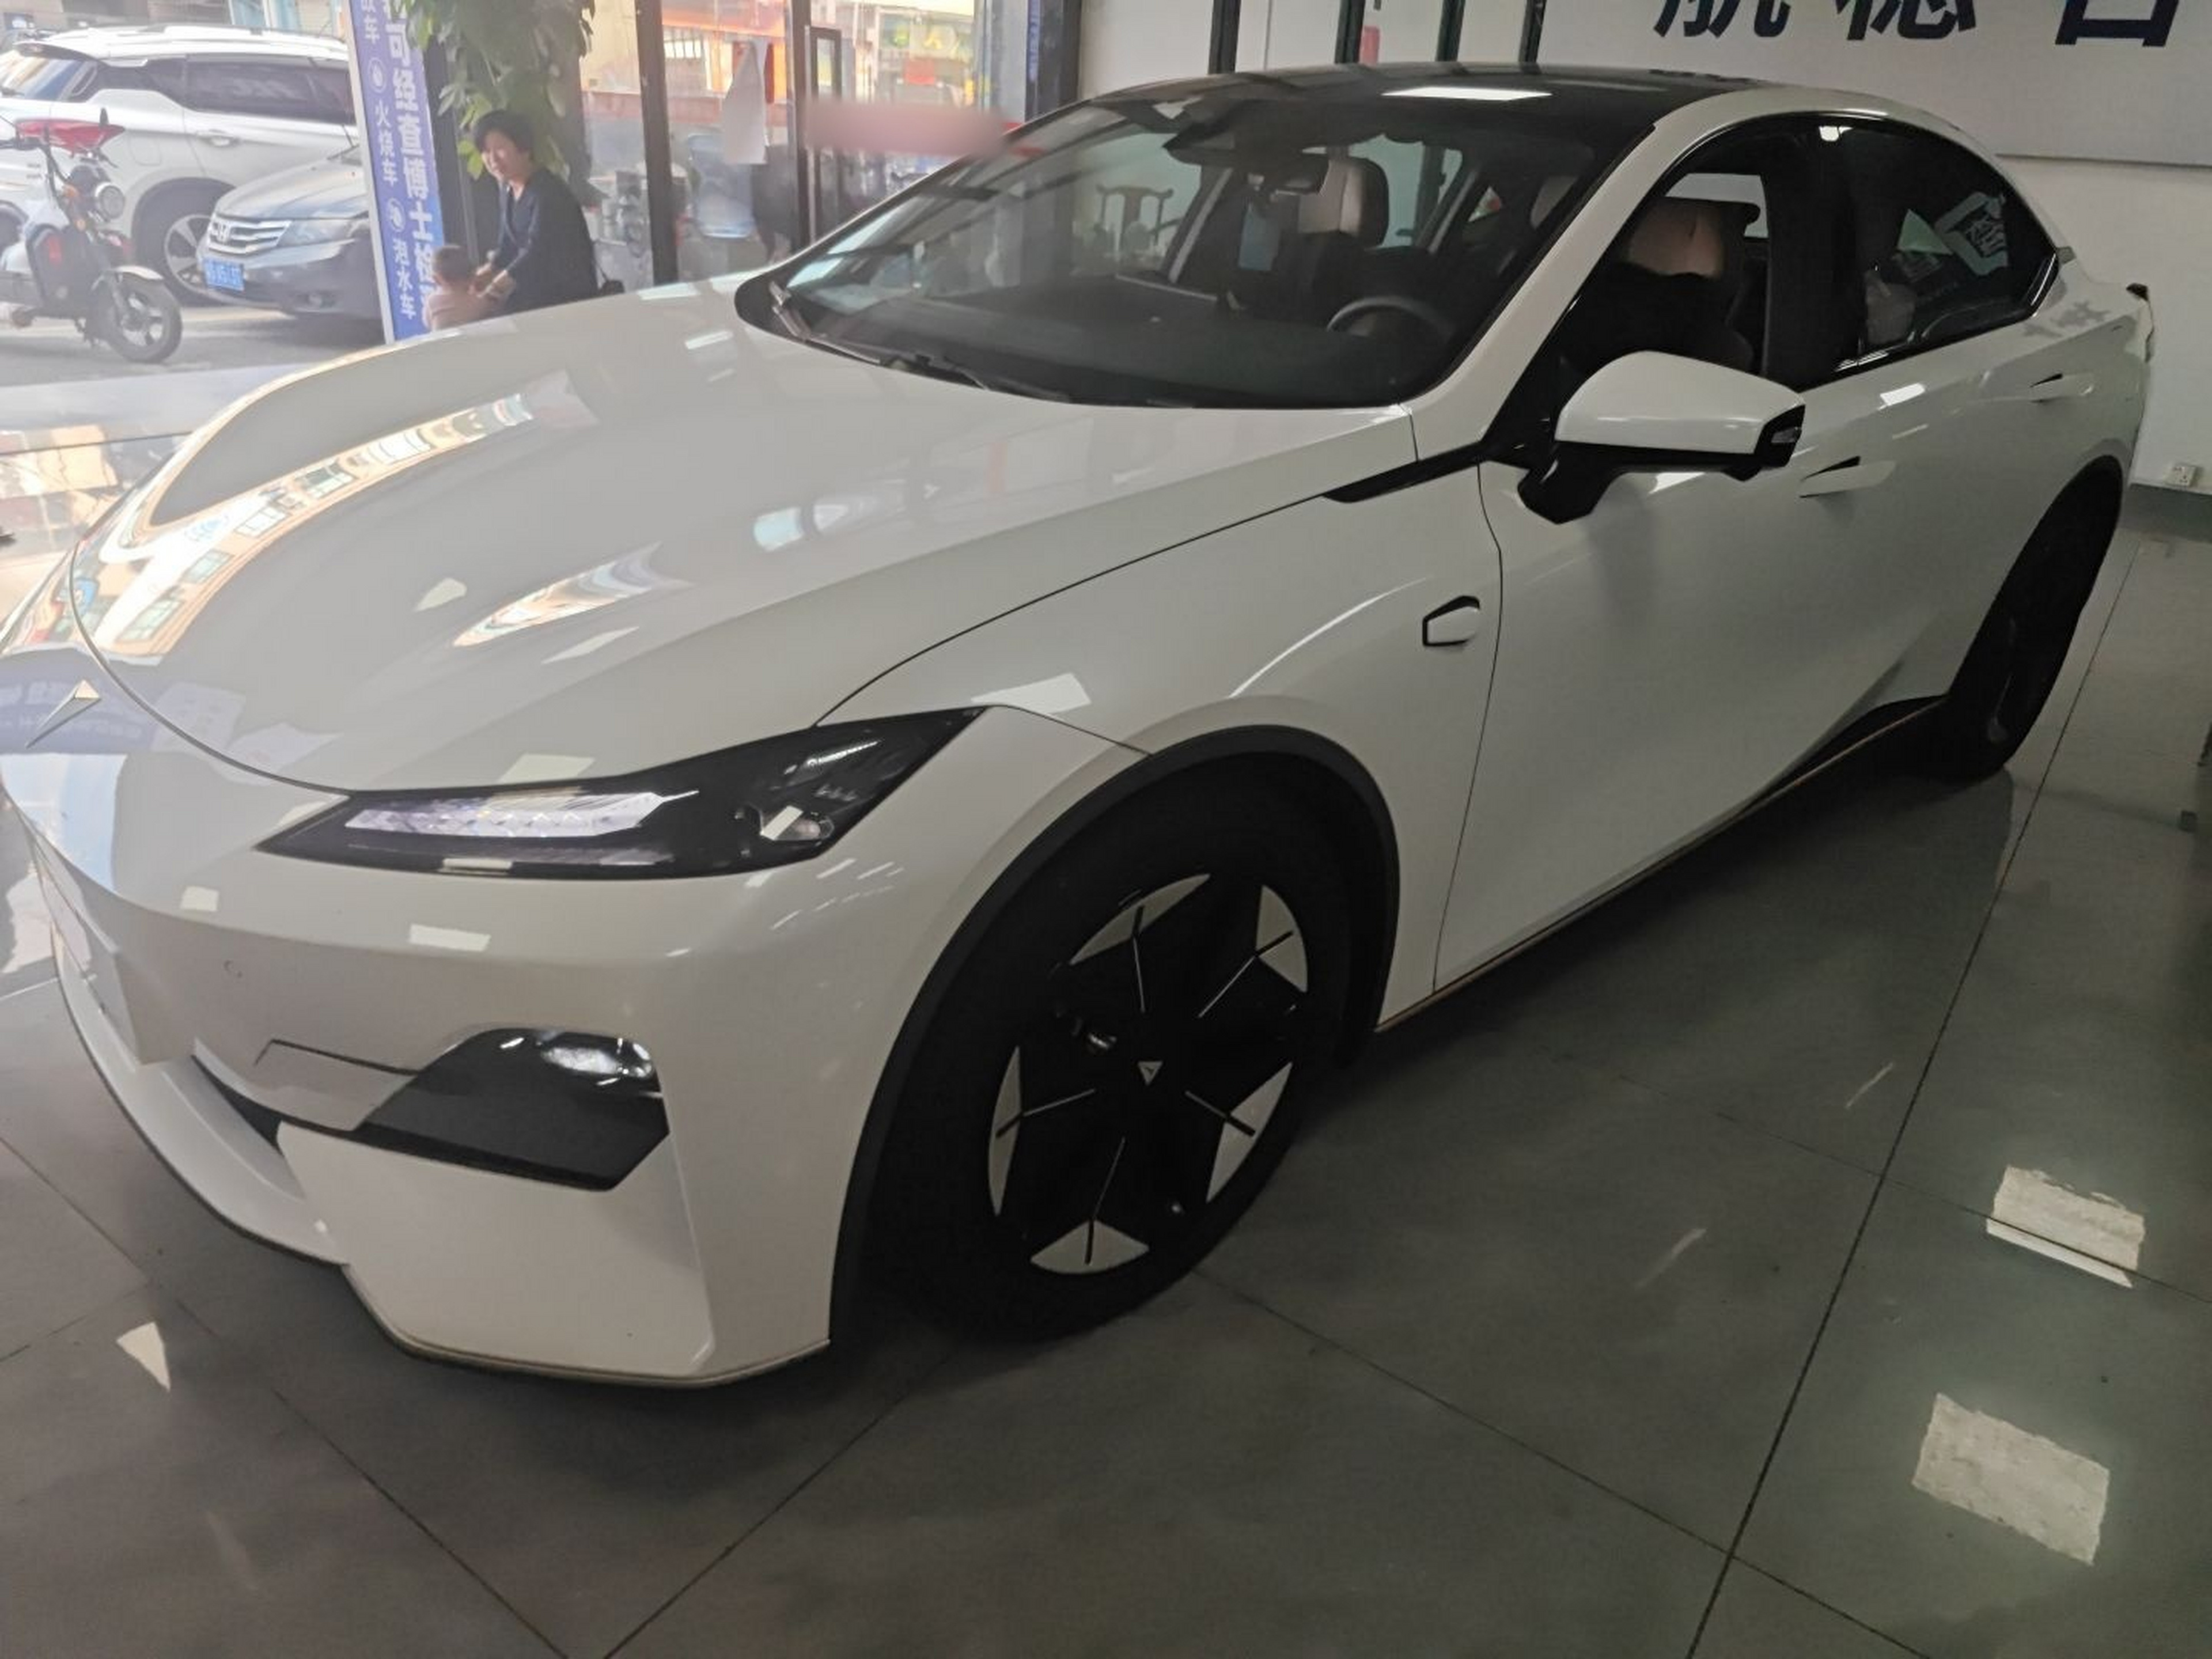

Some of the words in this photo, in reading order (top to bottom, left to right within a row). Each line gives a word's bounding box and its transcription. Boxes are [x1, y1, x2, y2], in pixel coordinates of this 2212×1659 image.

[375, 99, 398, 187] 火烧车
[382, 0, 436, 301] 可经查博士检
[393, 238, 416, 320] 泡水车
